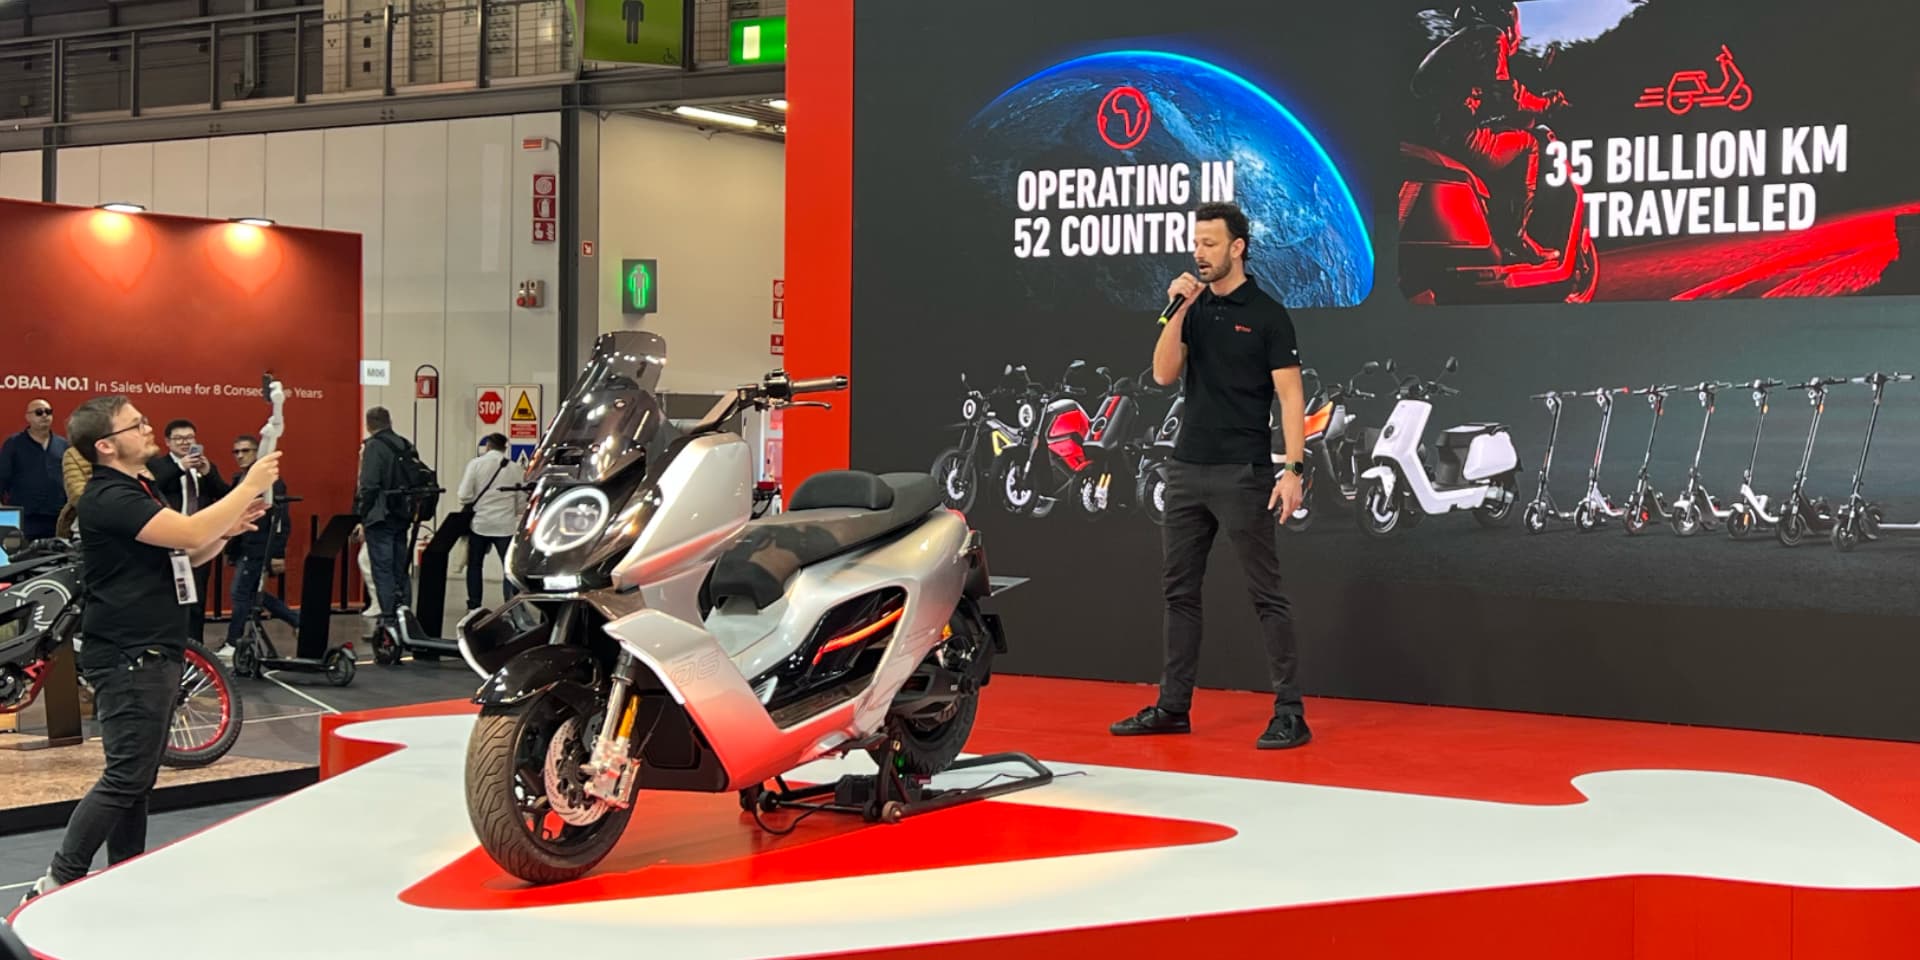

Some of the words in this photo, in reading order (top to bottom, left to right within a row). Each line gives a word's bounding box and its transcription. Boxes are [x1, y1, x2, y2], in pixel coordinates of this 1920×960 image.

[1545, 139, 1593, 186] 35
[1607, 129, 1766, 183] BILLION
[1781, 124, 1848, 175] KM
[1017, 162, 1191, 211] OPERATING
[1201, 160, 1234, 203] IN
[1582, 182, 1816, 238] TRAVELLED
[1014, 216, 1050, 258] 52
[1061, 211, 1197, 257] COUNTRI
[54, 376, 89, 391] NO.1
[95, 382, 107, 392] In
[110, 381, 143, 393] Sales
[145, 382, 191, 395] Volume
[194, 383, 210, 395] for
[213, 384, 220, 395] 8
[223, 384, 292, 398] Consece
[294, 387, 323, 399] Years
[479, 401, 502, 415] STOP
